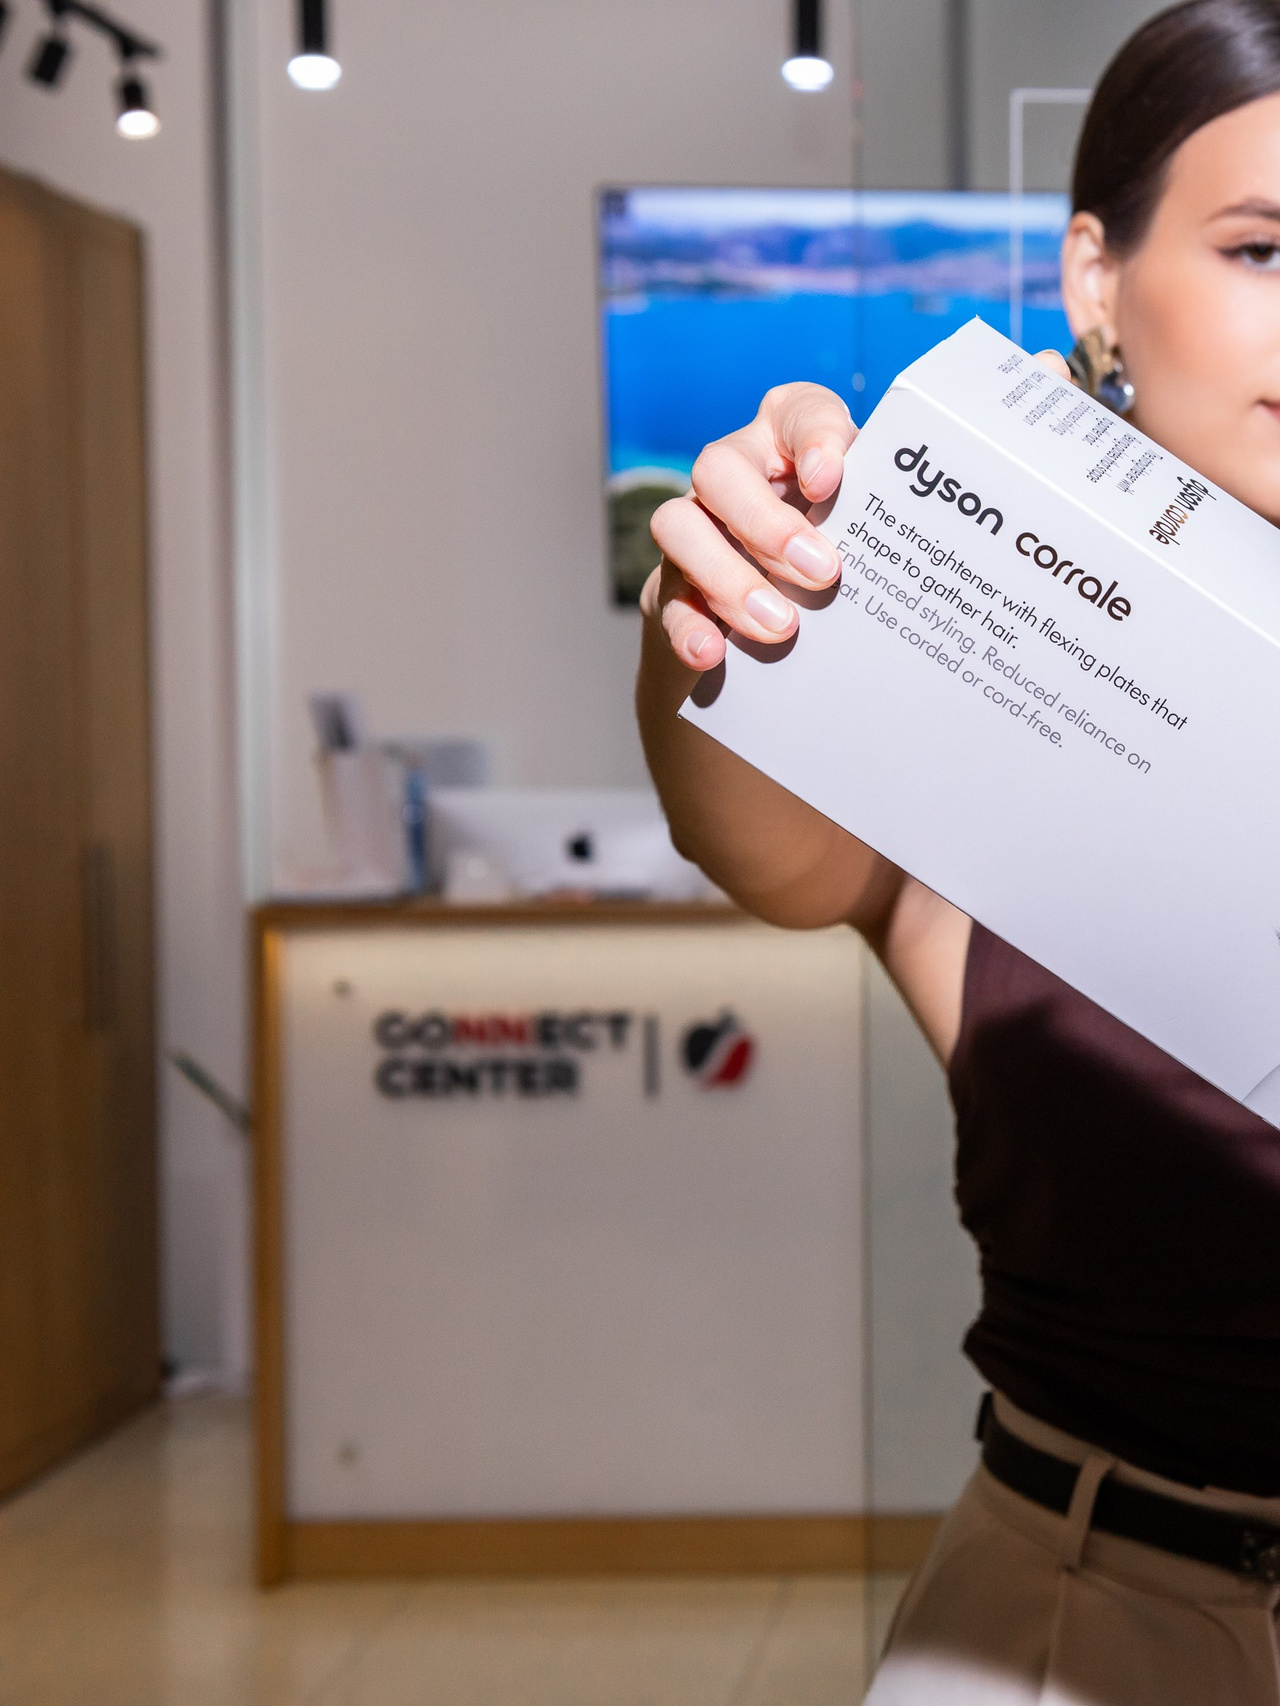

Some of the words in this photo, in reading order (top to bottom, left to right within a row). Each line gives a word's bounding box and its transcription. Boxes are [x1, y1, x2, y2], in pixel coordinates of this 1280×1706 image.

[894, 444, 1003, 536] dyson
[1015, 532, 1131, 621] corrale
[1149, 504, 1188, 546] corrale
[1174, 476, 1217, 512] dyson
[847, 522, 901, 565] shape
[902, 558, 920, 578] to
[920, 576, 982, 619] gather
[981, 610, 1018, 649] hair.
[865, 493, 896, 527] The
[897, 524, 1002, 599] straightener
[1003, 596, 1037, 627] with
[1039, 618, 1097, 671] flexing
[1094, 664, 1150, 705] plates
[1150, 698, 1188, 730] that
[865, 595, 898, 629] Use
[900, 627, 965, 674] corded
[962, 670, 984, 687] or
[983, 685, 1062, 748] cord-free.
[919, 607, 976, 654] styling.
[981, 645, 1061, 708] Reduced
[1057, 703, 1126, 755] reliance
[1127, 753, 1151, 774] on
[374, 1011, 632, 1050] CONNECT
[375, 1059, 580, 1099] CENTER
